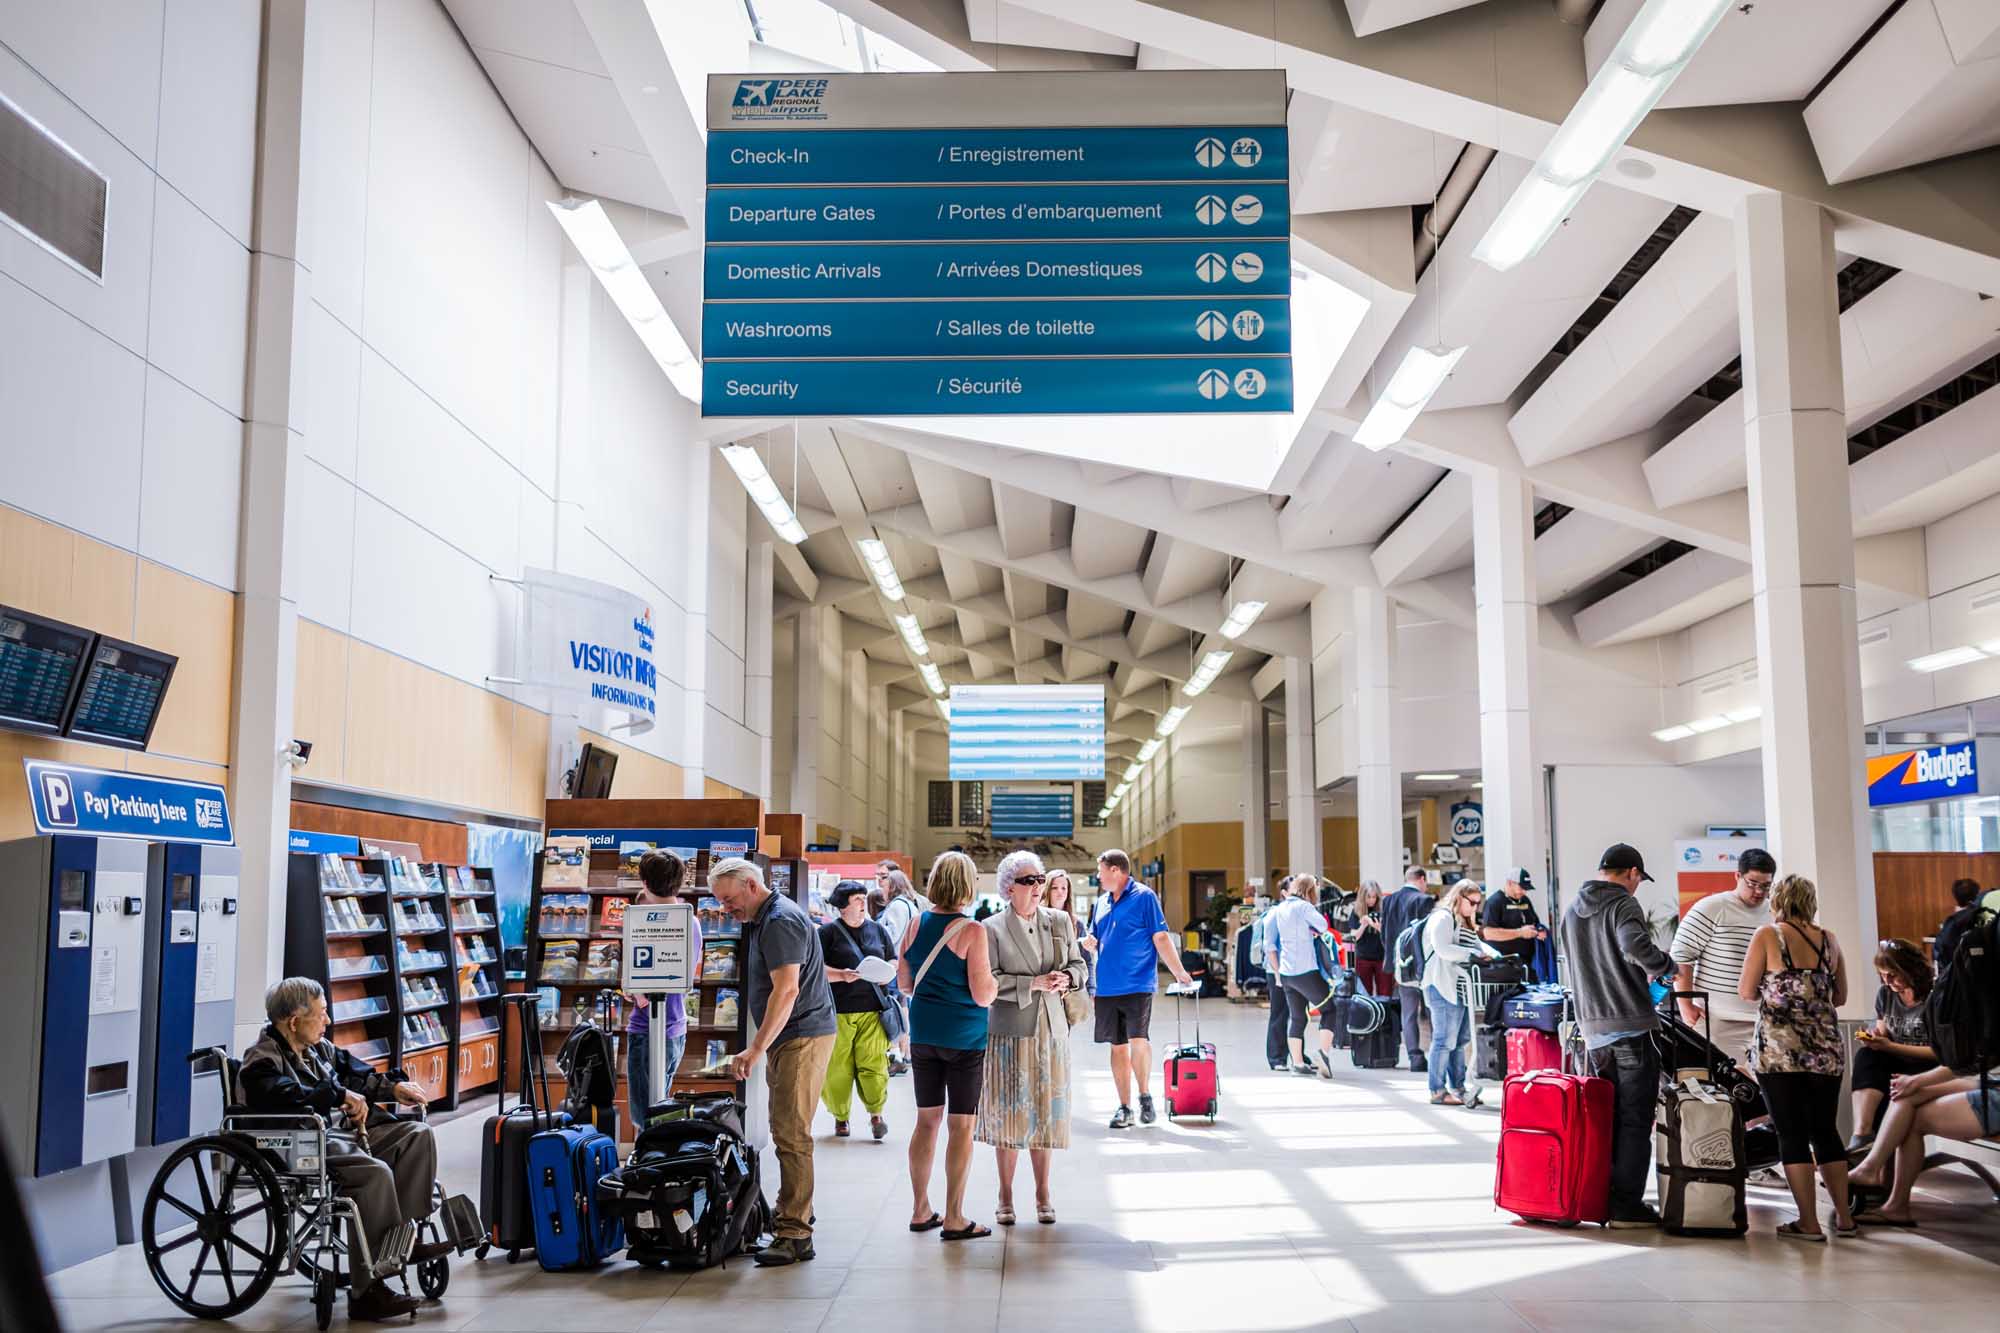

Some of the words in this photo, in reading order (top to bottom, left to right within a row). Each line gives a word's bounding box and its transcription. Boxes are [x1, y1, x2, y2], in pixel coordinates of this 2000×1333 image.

[776, 89, 825, 97] LAKE
[779, 80, 828, 88] DEER
[771, 106, 819, 115] airport
[731, 148, 809, 164] Check-In
[950, 146, 1084, 166] Enregistrement
[729, 206, 817, 225] Departure
[823, 205, 876, 221] Gates
[949, 204, 1006, 220] Portes
[1012, 203, 1162, 222] d'embarquement
[728, 263, 811, 280] Domestic
[815, 263, 881, 279] Arrivals
[946, 260, 1019, 278] Arrivées
[1026, 261, 1143, 280] Domestiques
[726, 321, 832, 338] Washrooms
[948, 319, 1002, 336] Salles
[1007, 319, 1030, 336] de
[1036, 319, 1095, 335] toilette
[726, 379, 799, 400] Security
[948, 376, 1022, 394] Sécurité
[570, 640, 633, 681] VISITOR
[1916, 745, 1972, 787] Budget
[46, 777, 69, 820] P
[84, 792, 109, 820] Pay
[110, 794, 159, 824] Parking
[160, 799, 188, 821] here
[636, 948, 650, 967] P
